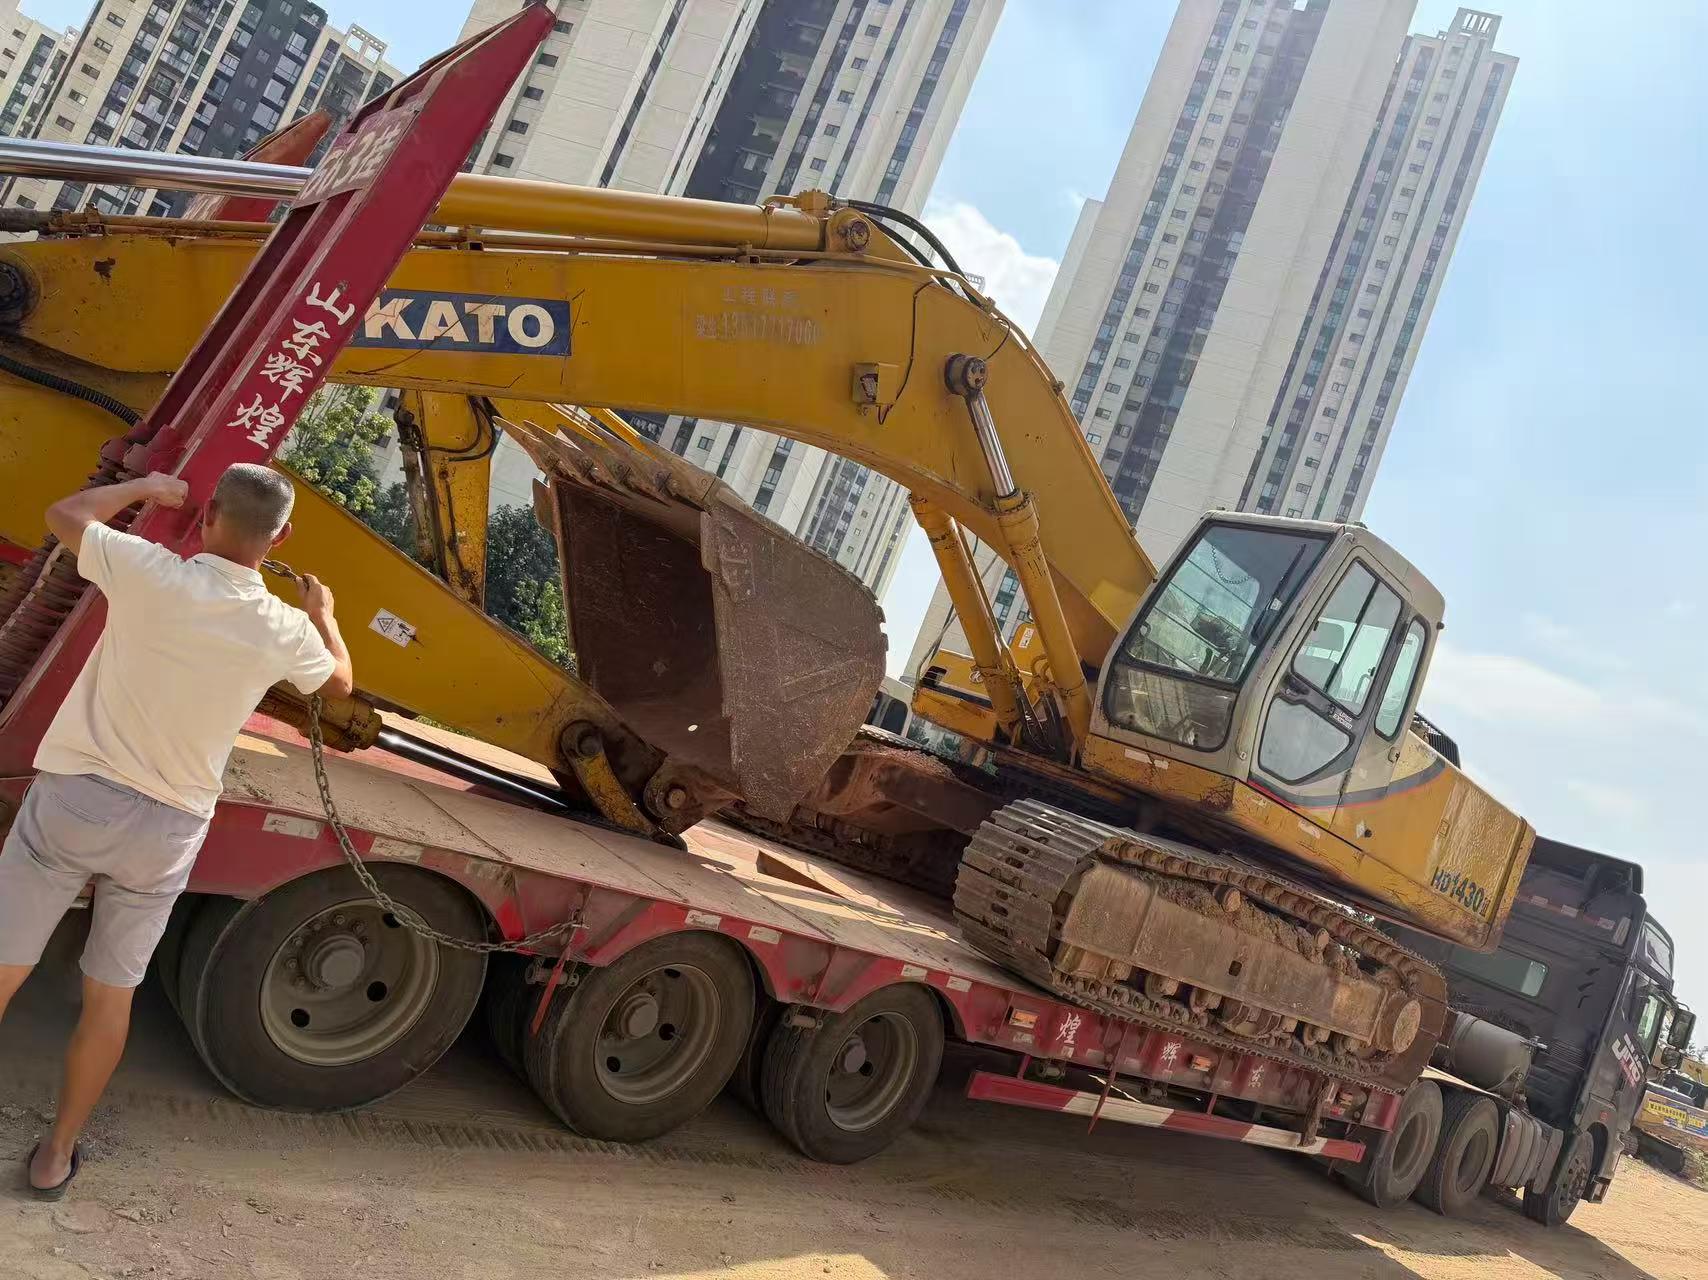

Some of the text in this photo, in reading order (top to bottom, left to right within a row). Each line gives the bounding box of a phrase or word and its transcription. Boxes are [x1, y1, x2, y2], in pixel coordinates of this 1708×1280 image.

[226, 281, 356, 450] 山东辉煌
[364, 296, 556, 348] KATO
